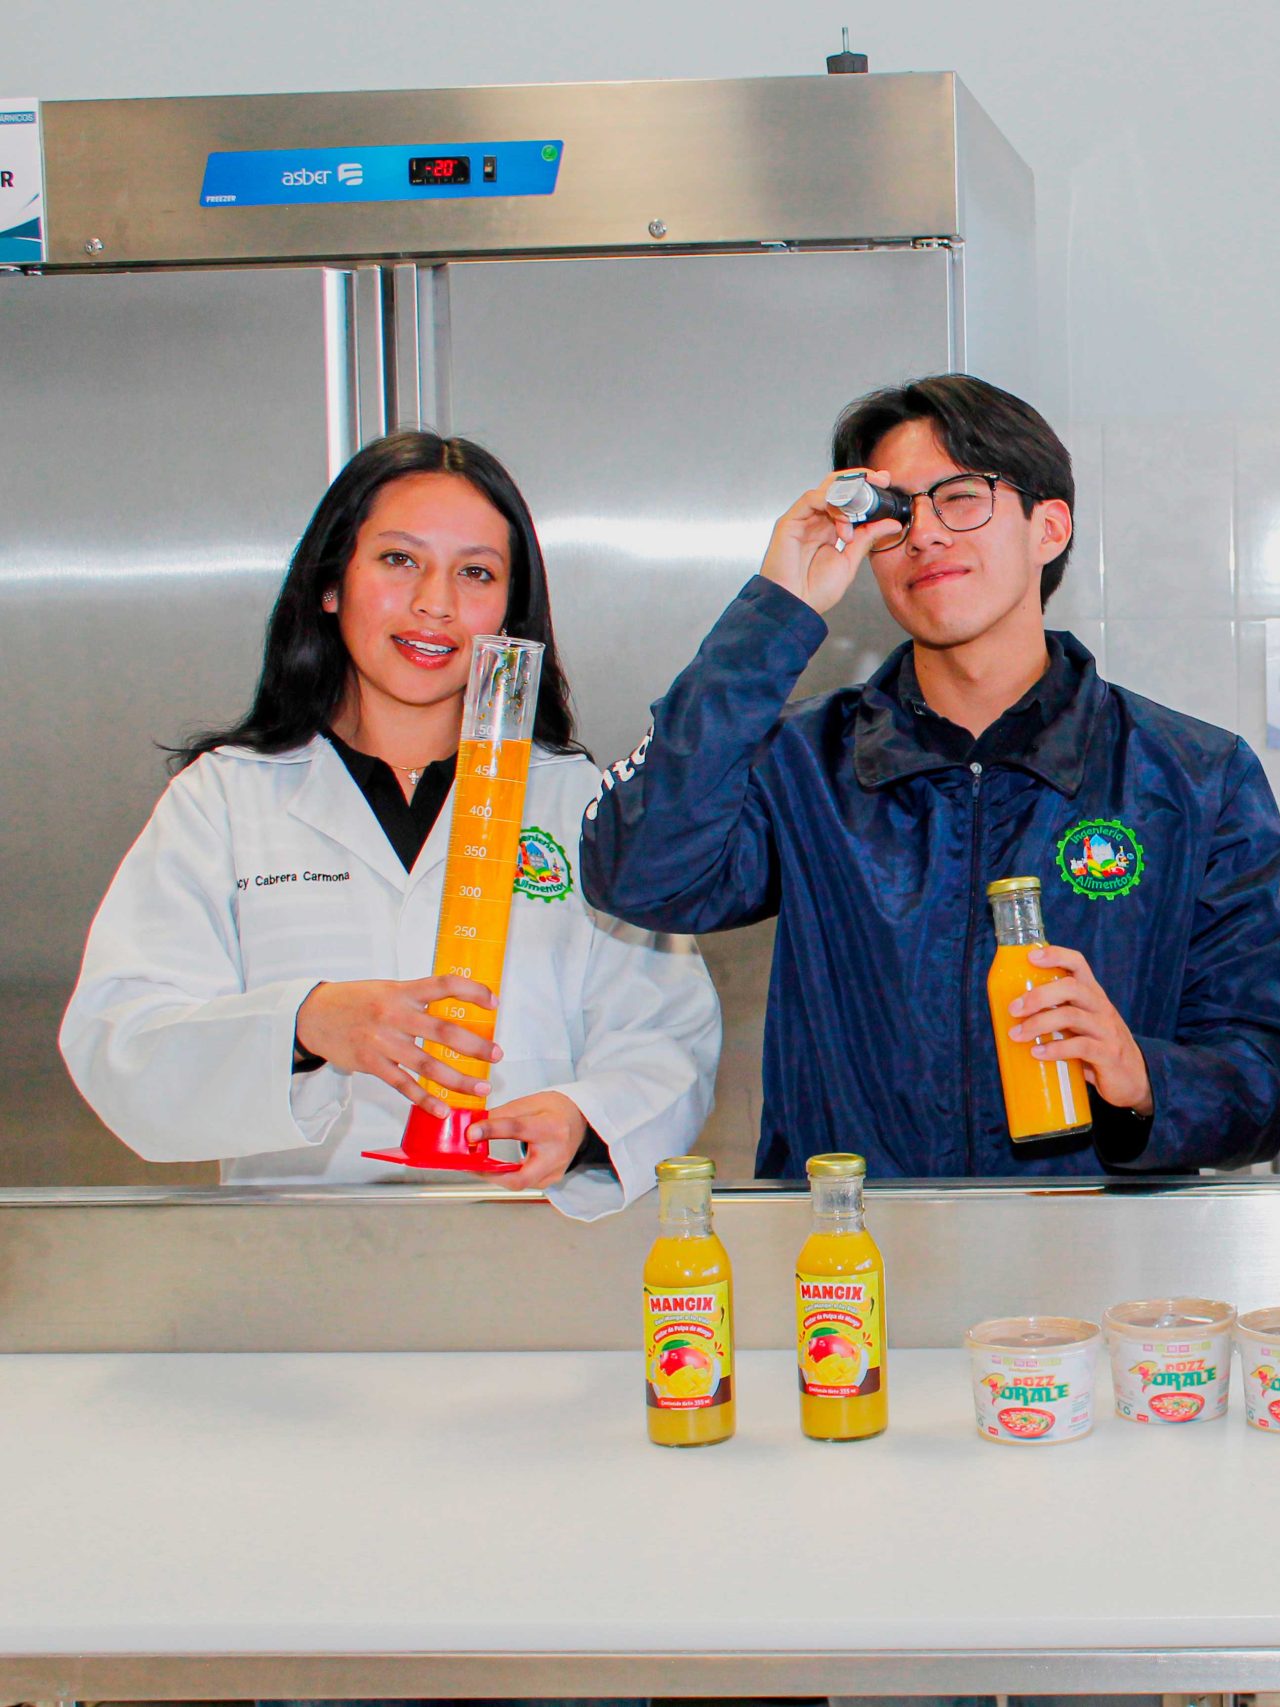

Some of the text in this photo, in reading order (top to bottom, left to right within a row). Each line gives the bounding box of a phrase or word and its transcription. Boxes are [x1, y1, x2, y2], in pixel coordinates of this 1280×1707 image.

[282, 168, 332, 186] asber
[206, 195, 236, 203] FREEZER
[469, 805, 492, 818] 400
[464, 845, 487, 858] 350
[255, 872, 298, 887] Cabrera
[303, 871, 350, 883] Carmona
[1075, 873, 1132, 889] Alimentos
[459, 885, 482, 898] 300
[453, 925, 477, 938] 250
[444, 1006, 465, 1019] 150
[1013, 1375, 1057, 1387] POZZ
